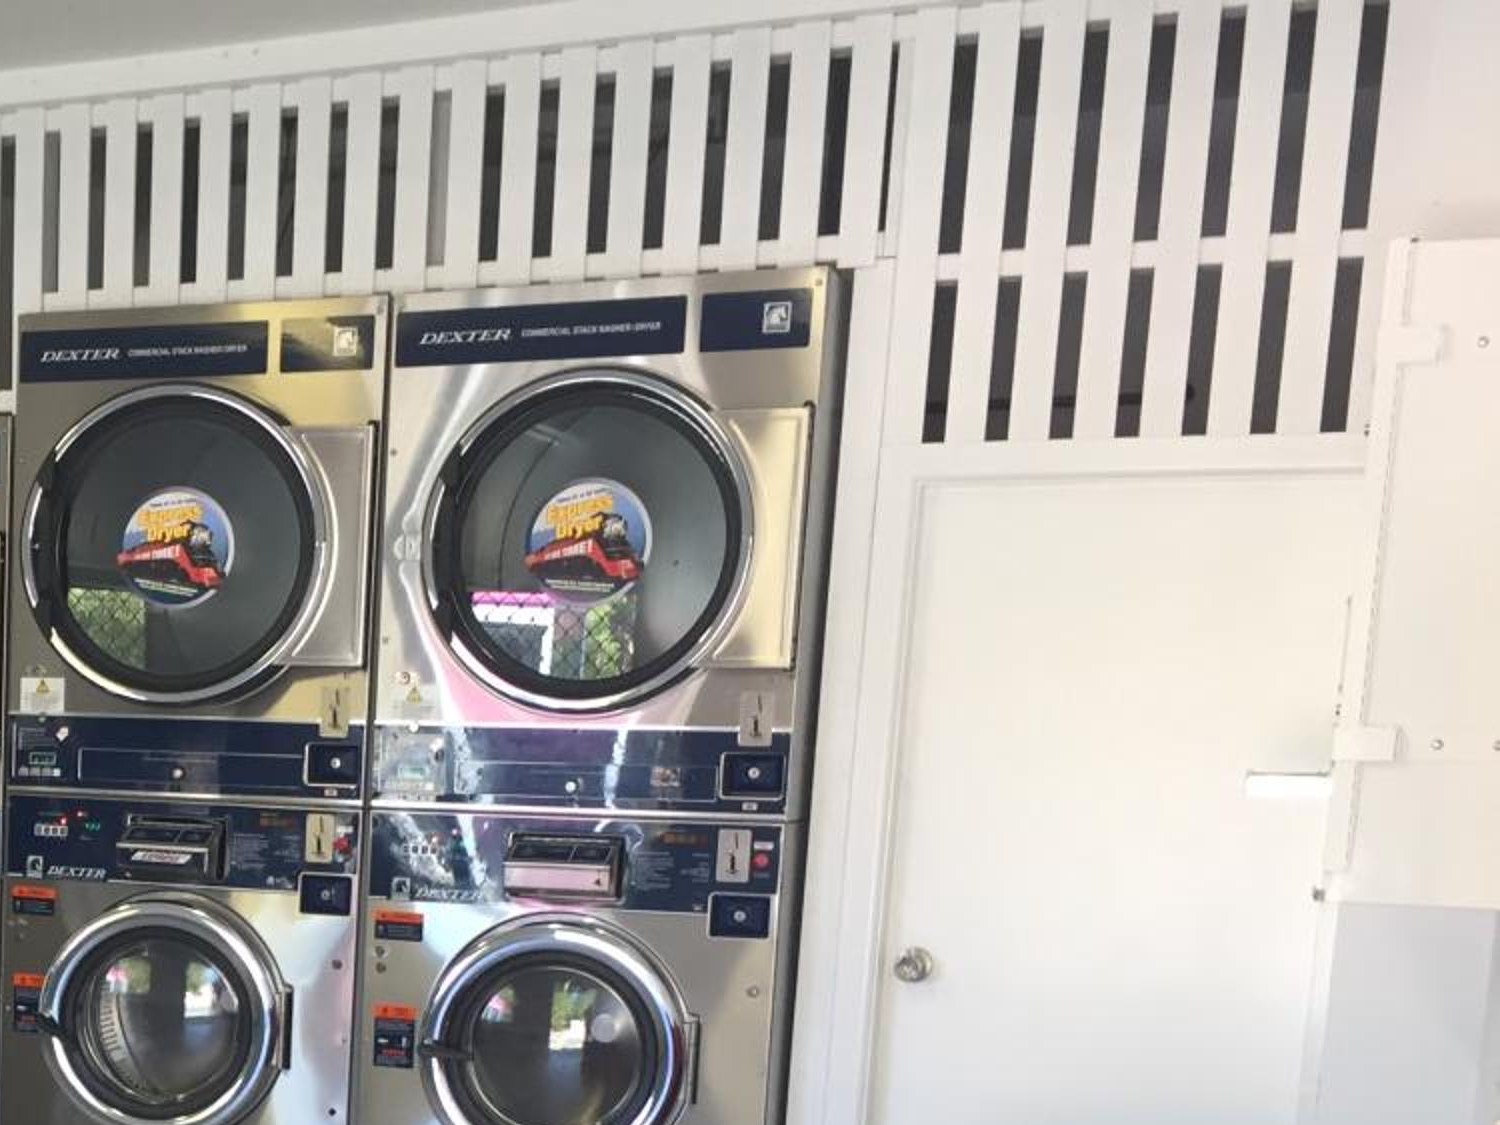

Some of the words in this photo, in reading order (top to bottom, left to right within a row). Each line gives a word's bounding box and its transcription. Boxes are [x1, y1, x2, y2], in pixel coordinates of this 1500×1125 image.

[418, 328, 512, 345] DEXTER
[40, 347, 121, 363] DEXTER
[47, 865, 108, 880] DEXTER
